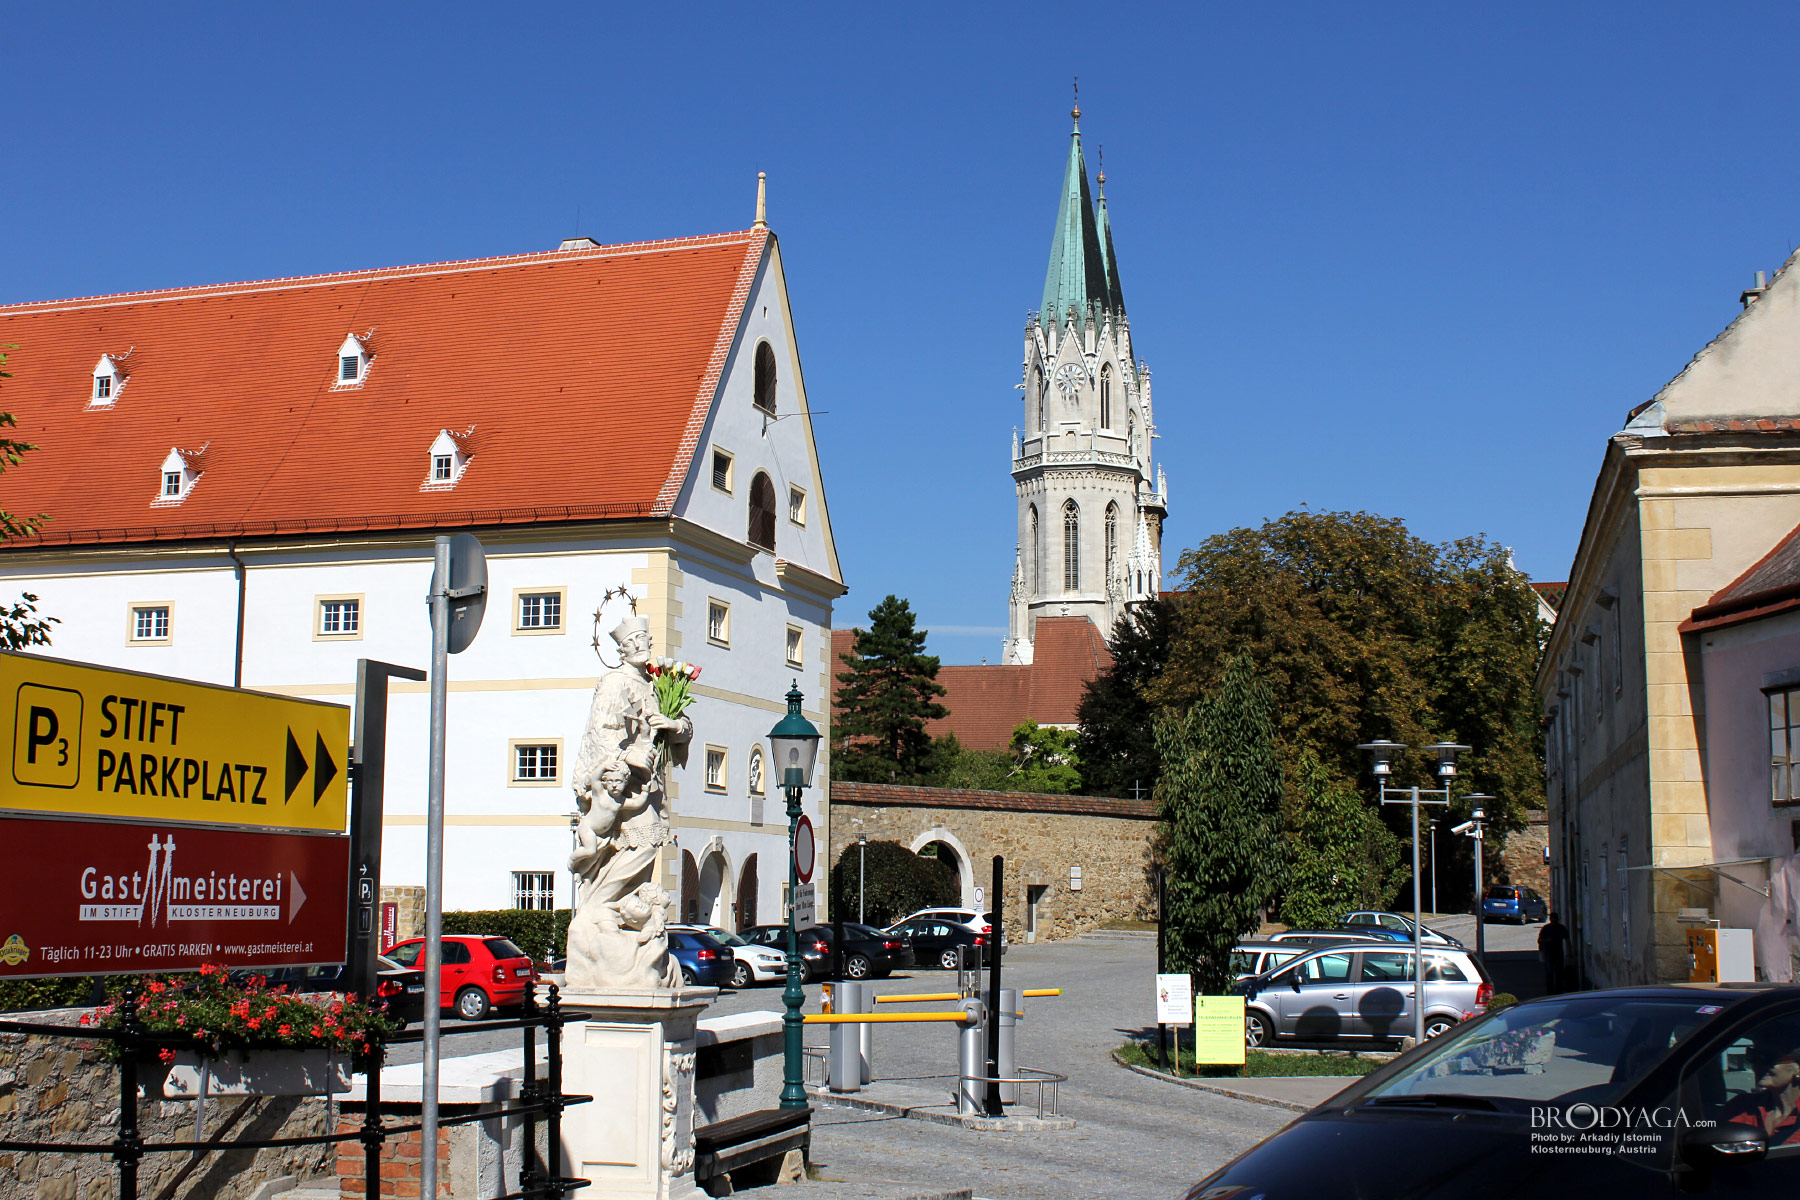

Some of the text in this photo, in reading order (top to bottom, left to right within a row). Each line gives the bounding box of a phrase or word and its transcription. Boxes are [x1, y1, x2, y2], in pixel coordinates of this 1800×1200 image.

[100, 695, 185, 745] STIFT
[97, 748, 268, 806] PARKPLATZ
[81, 866, 142, 899] Gast
[173, 870, 282, 900] meisterei
[84, 907, 277, 918] IM STIFT KLOSTERNEUBURG
[40, 941, 314, 963] Täglich 11-23 Uhr GRATIS PARKEN www.gastmeisterei.at
